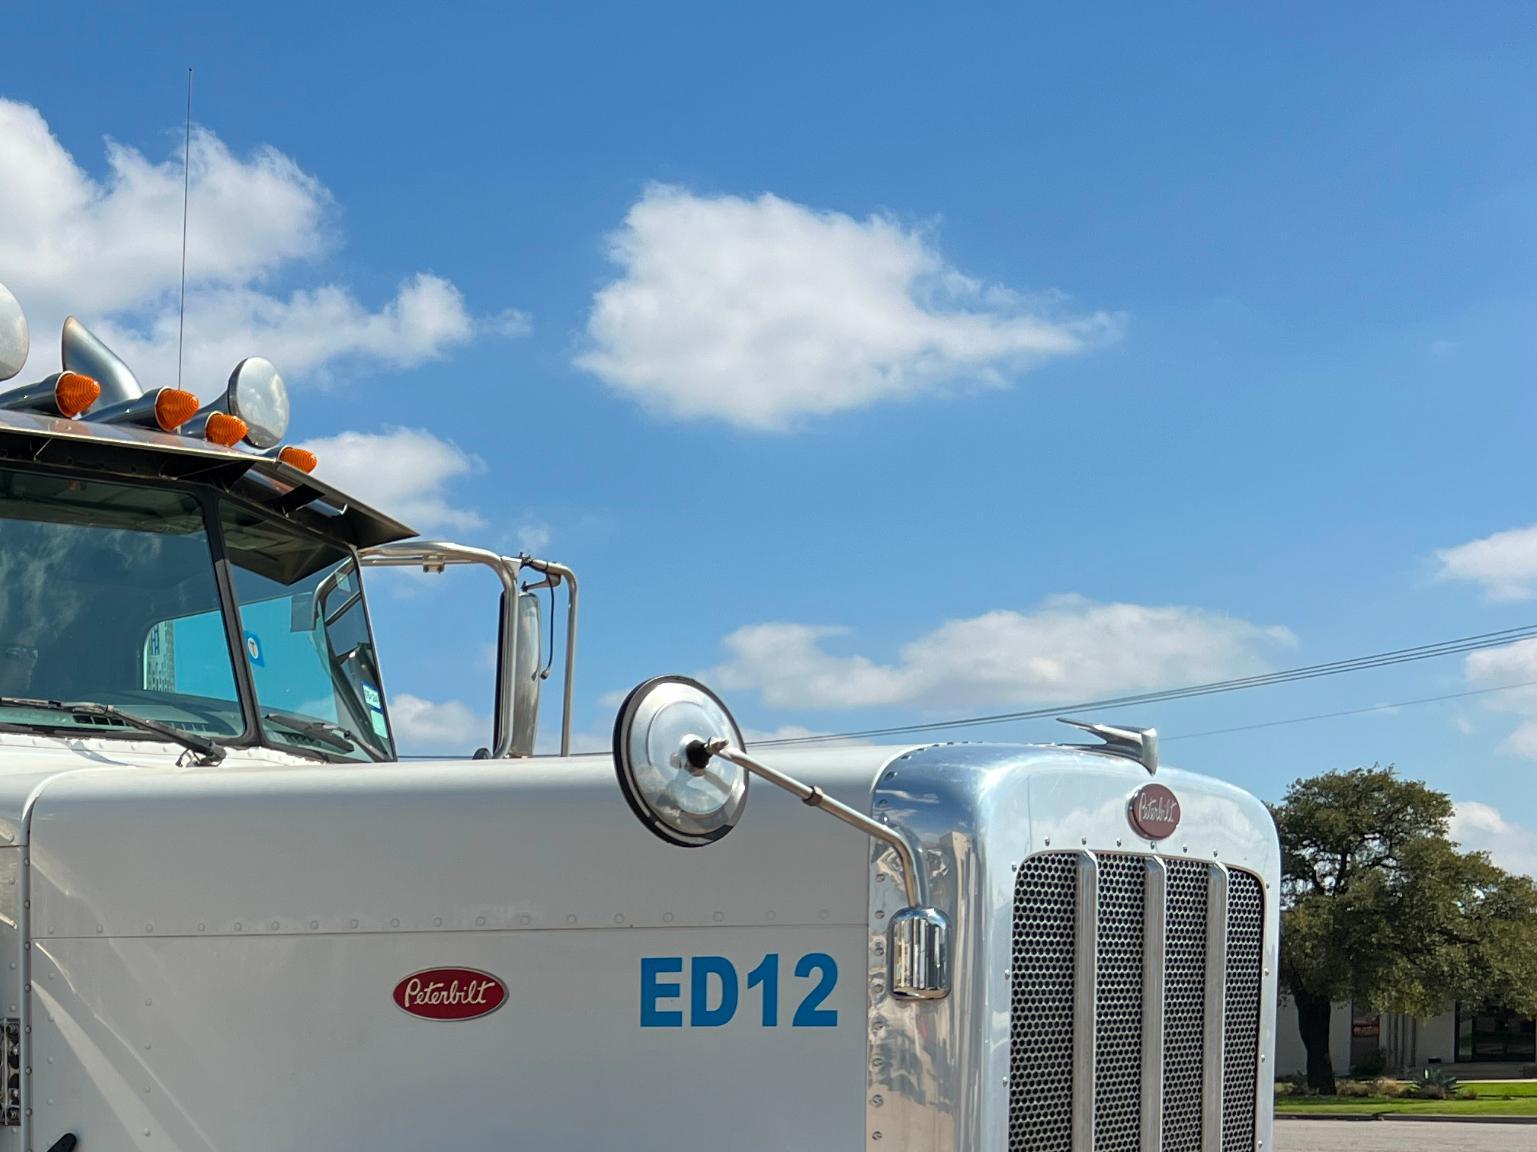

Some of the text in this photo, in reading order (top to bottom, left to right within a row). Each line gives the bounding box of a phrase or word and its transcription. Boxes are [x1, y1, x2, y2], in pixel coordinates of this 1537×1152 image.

[1138, 792, 1178, 823] Peterbilt
[404, 978, 496, 1008] Peterbilt
[639, 952, 839, 1028] ED12
